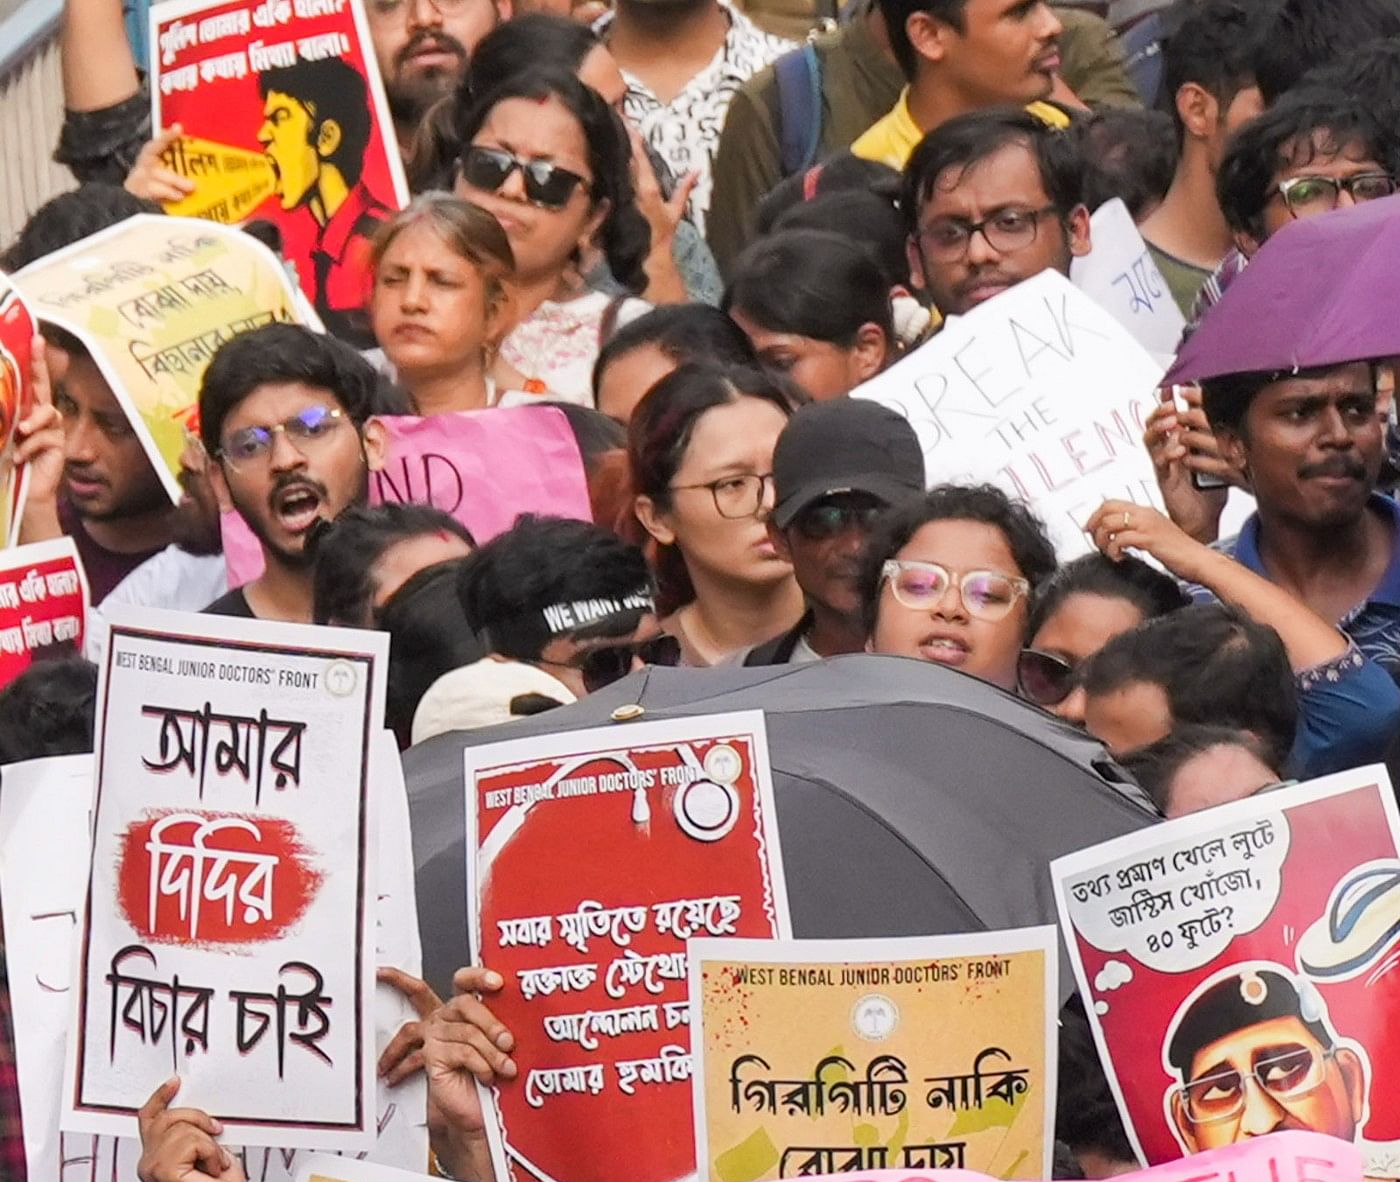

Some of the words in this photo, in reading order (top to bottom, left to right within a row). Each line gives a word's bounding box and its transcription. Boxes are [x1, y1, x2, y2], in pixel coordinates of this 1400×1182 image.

[997, 399, 1060, 451] THE
[373, 452, 465, 516] ND
[542, 603, 571, 633] WE
[116, 652, 136, 668] WEST
[138, 654, 174, 674] BENGAL
[177, 658, 216, 678] JUNIOR
[218, 663, 276, 684] DOCTORS'
[278, 668, 320, 690] FRONT
[141, 701, 308, 807] আমার
[485, 787, 512, 808] WEST
[513, 783, 555, 805] BENGAL
[557, 778, 598, 801] JUNIOR
[599, 767, 659, 798] DOCTORS'
[660, 764, 702, 786] FRONT
[145, 811, 280, 940] দিদির
[1071, 877, 1111, 905] তথ্য
[1115, 857, 1167, 889] প্রমাণ
[1172, 839, 1227, 873] খেলে
[1230, 820, 1276, 861] লুটে
[497, 915, 552, 947] সবার
[556, 899, 648, 954] স্মৃতিতে
[652, 895, 742, 940] রয়েছে
[1108, 889, 1175, 928] জাস্টিস
[1179, 869, 1262, 907] খোঁজো,
[1145, 930, 1174, 954] ৪০
[1178, 906, 1235, 950] ফুটে?
[106, 944, 216, 1073] বিচার
[228, 960, 334, 1082] চাই
[515, 968, 598, 1002] রক্তাক্ত
[543, 1004, 660, 1050] আন্দোলন
[729, 1054, 909, 1117] গিরগিটি
[924, 1047, 1030, 1113] নাকি
